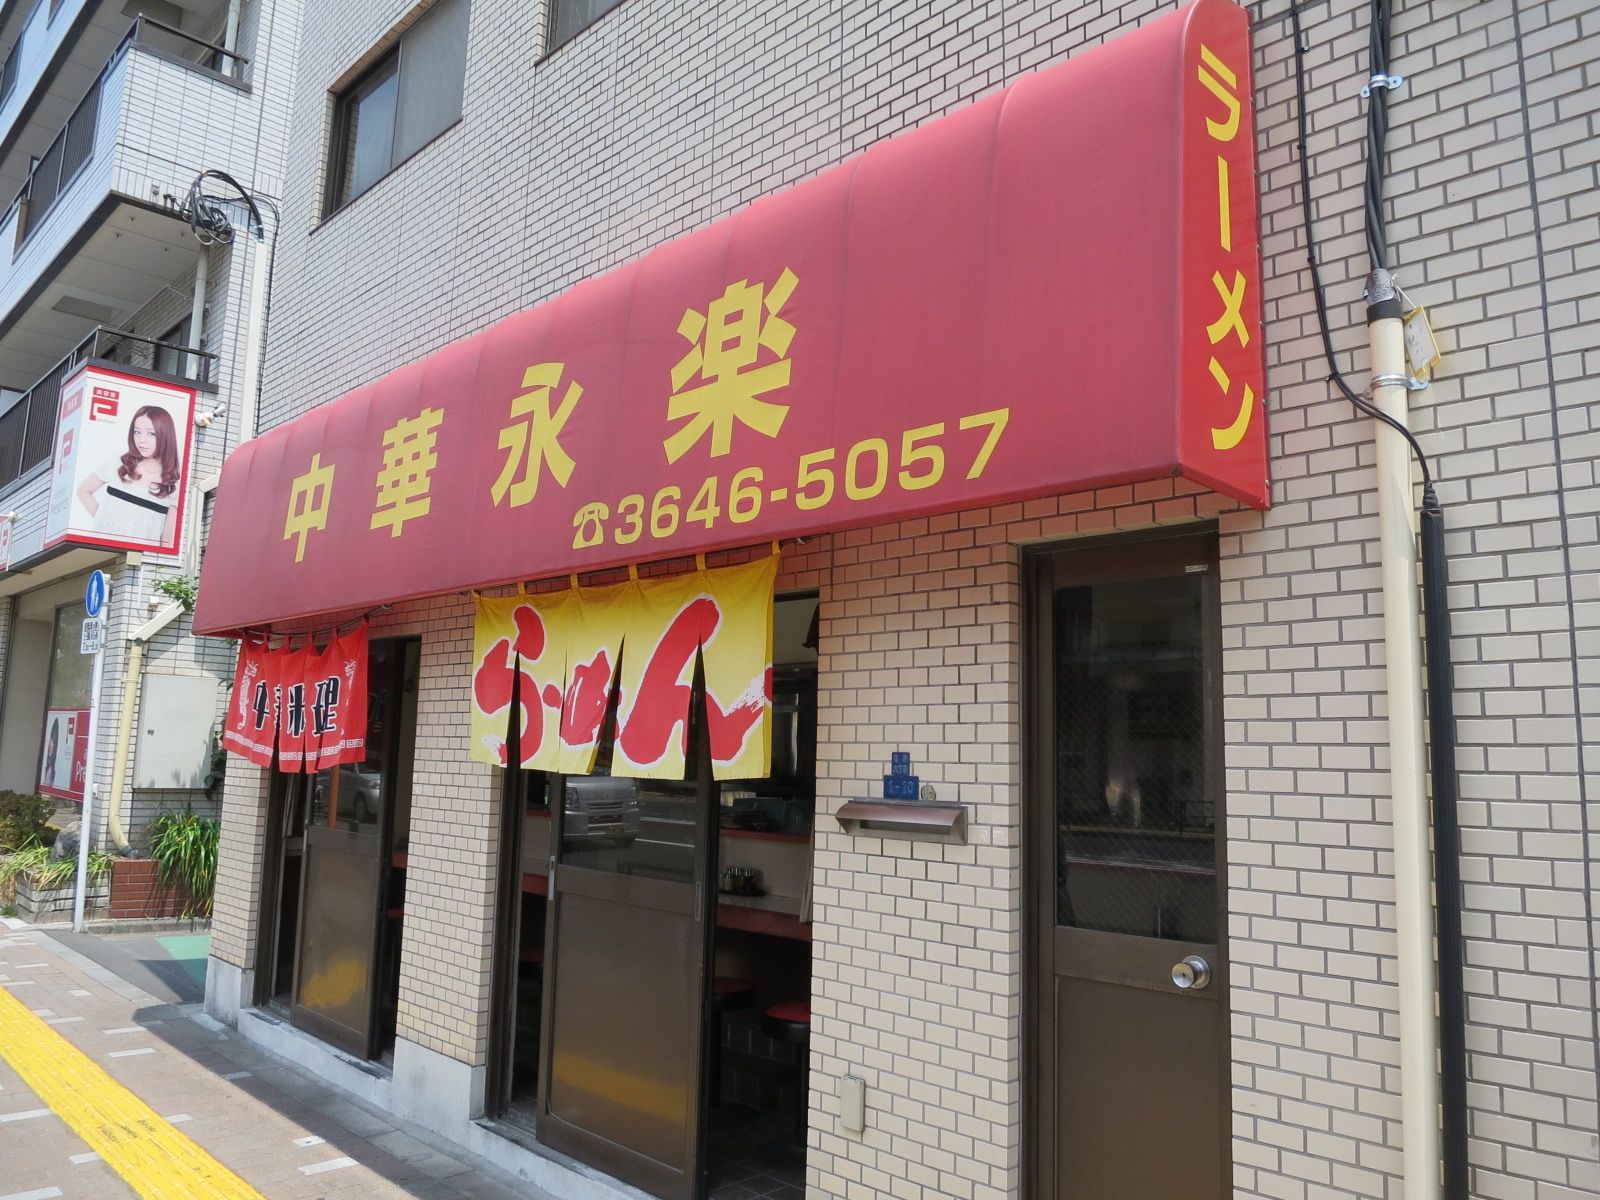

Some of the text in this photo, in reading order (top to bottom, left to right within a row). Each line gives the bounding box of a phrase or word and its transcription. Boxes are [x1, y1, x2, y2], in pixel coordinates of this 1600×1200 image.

[1198, 43, 1254, 450] ラーメン
[614, 407, 1010, 545] 3646-5057
